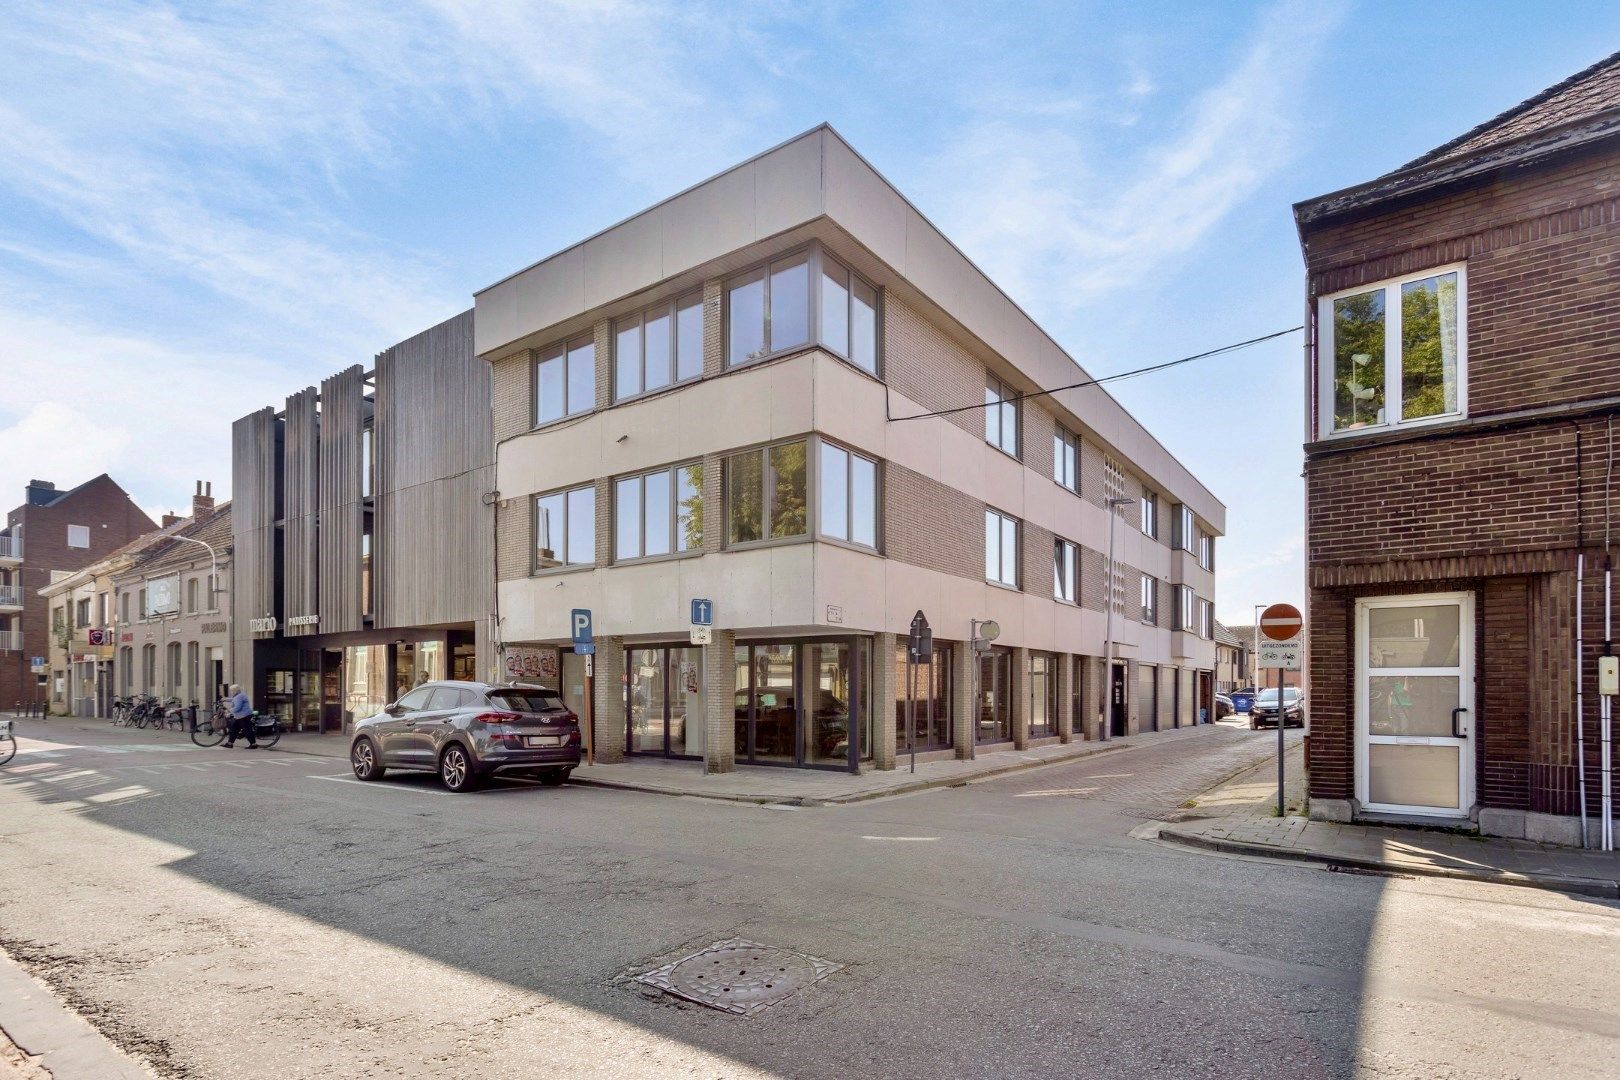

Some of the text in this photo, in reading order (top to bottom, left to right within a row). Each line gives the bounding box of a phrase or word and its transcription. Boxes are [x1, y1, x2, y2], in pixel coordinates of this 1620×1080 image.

[249, 613, 276, 631] mario
[288, 615, 319, 625] PATISSERIE
[575, 614, 589, 637] P
